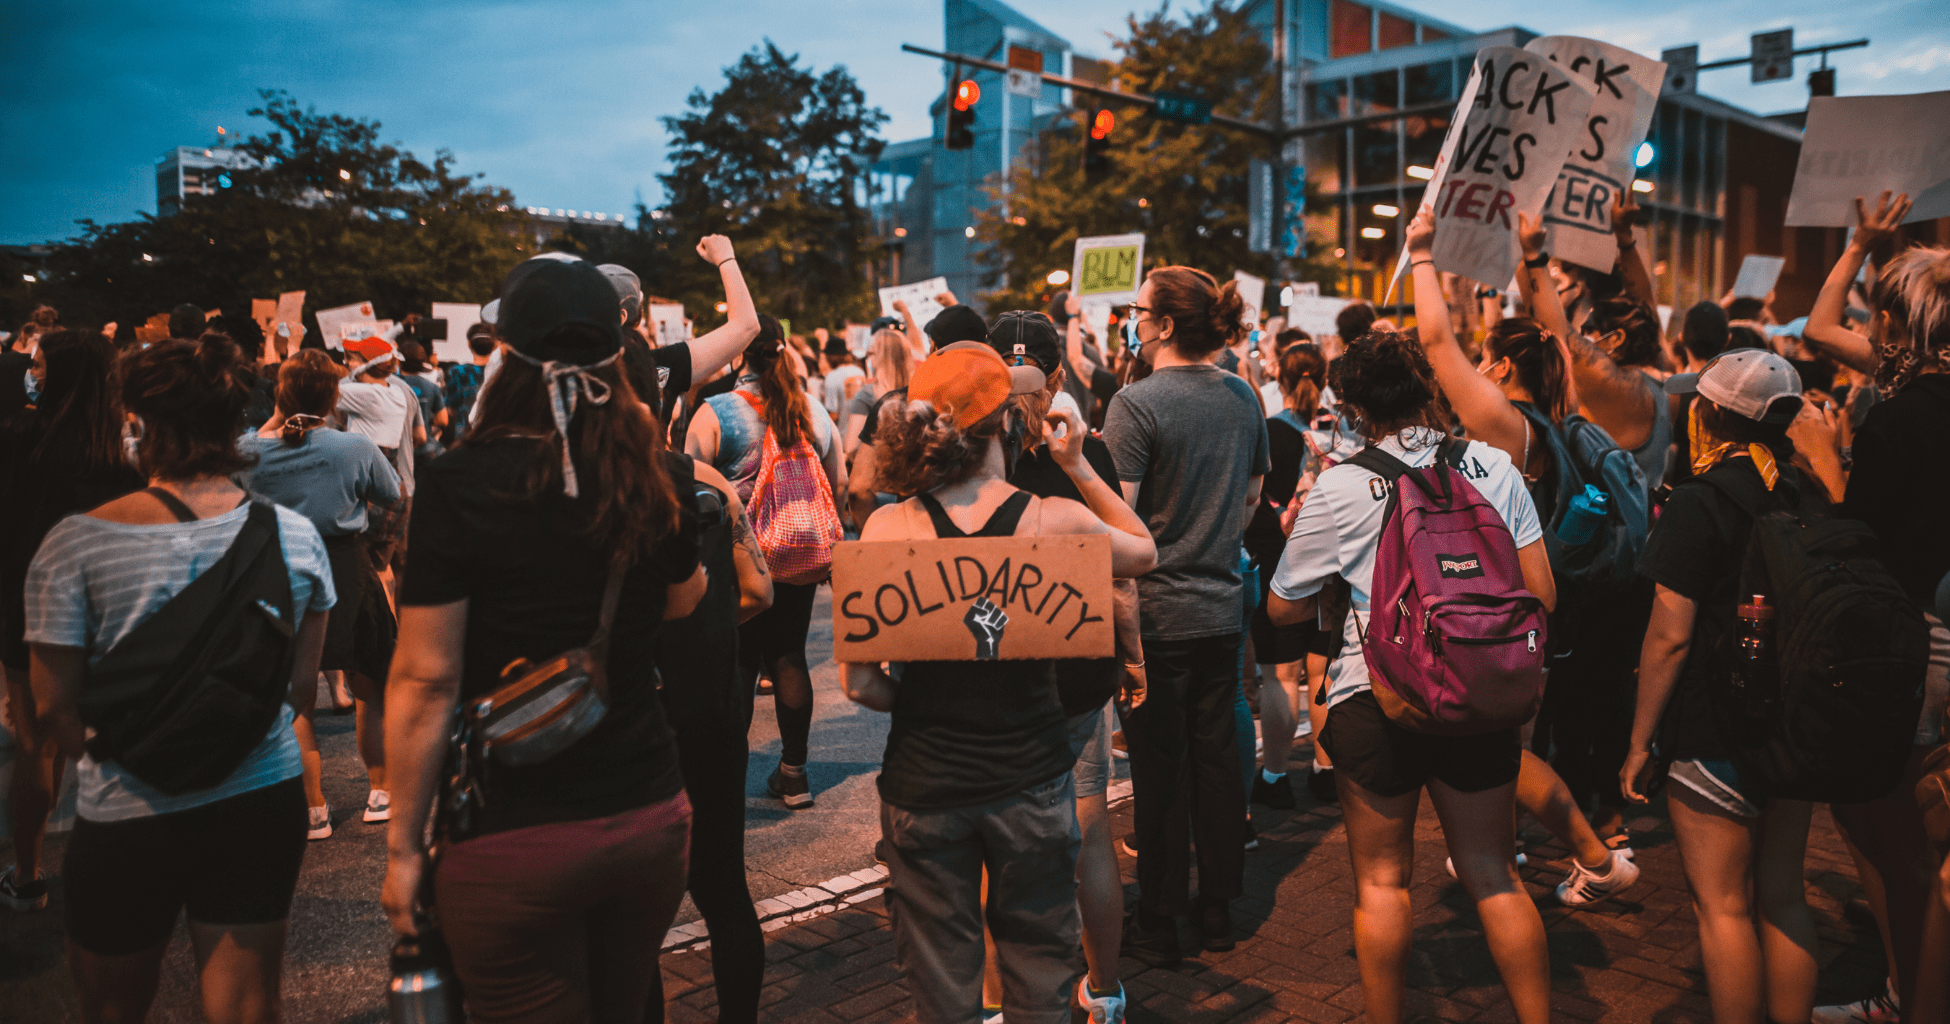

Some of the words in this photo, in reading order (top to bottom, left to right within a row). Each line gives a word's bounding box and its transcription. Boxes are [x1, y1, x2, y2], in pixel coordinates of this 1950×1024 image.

[1473, 58, 1570, 125] ACK
[1452, 122, 1537, 181] VES
[1440, 179, 1516, 231] TER
[1083, 249, 1136, 290] BLM
[841, 555, 1104, 643] SOLIDARITY
